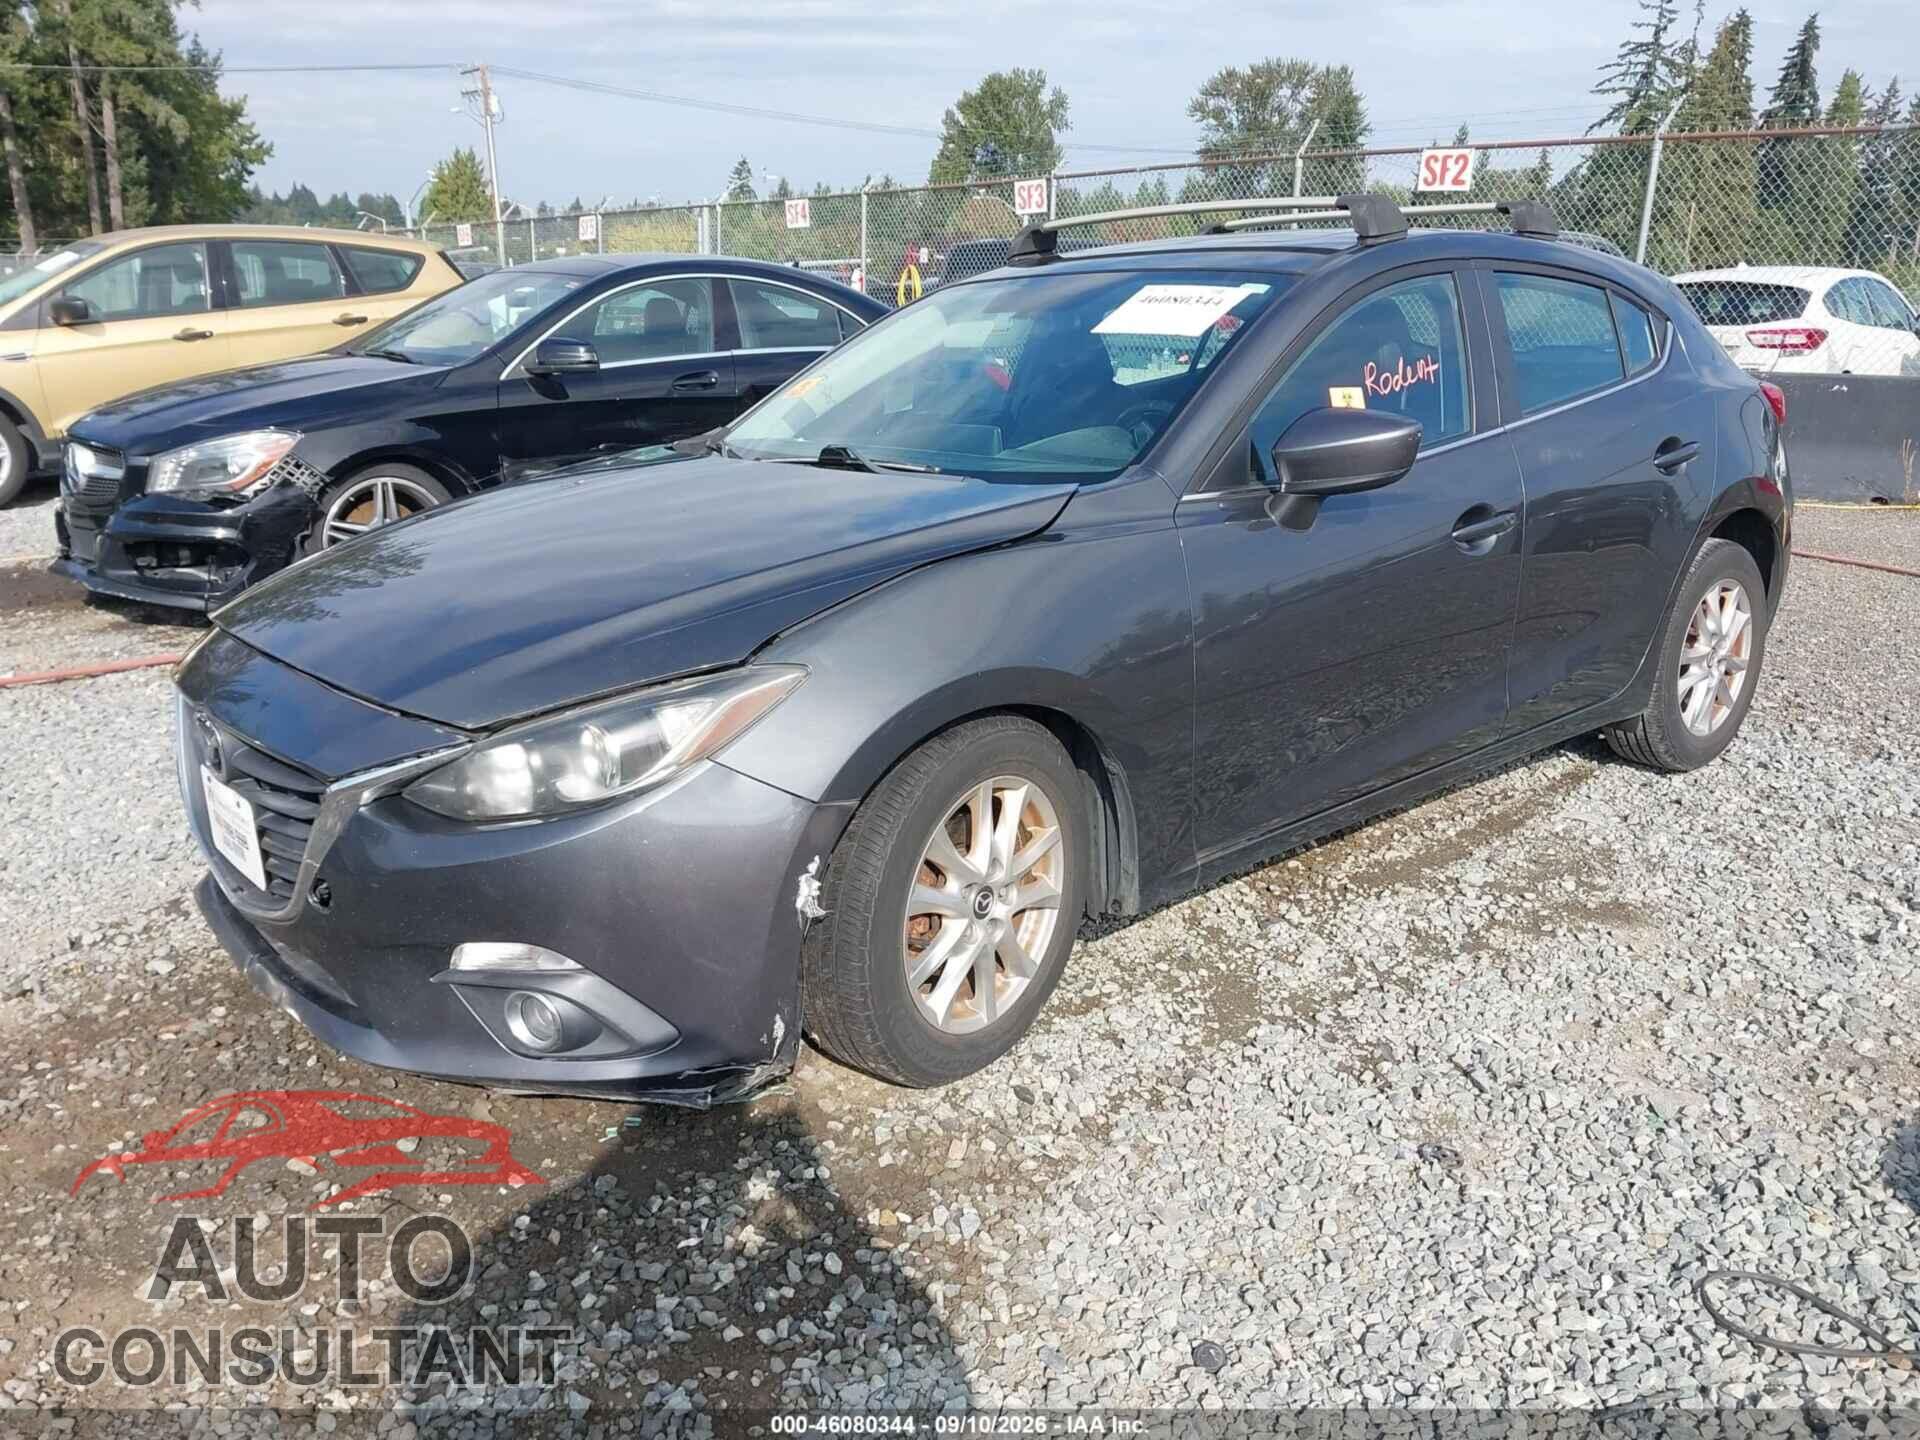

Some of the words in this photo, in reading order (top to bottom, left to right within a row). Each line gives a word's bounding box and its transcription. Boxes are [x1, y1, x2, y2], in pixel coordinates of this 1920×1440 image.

[1422, 153, 1470, 187] SF2
[1017, 183, 1045, 209] SF3
[787, 203, 808, 225] SF4
[1364, 353, 1440, 397] Rodent
